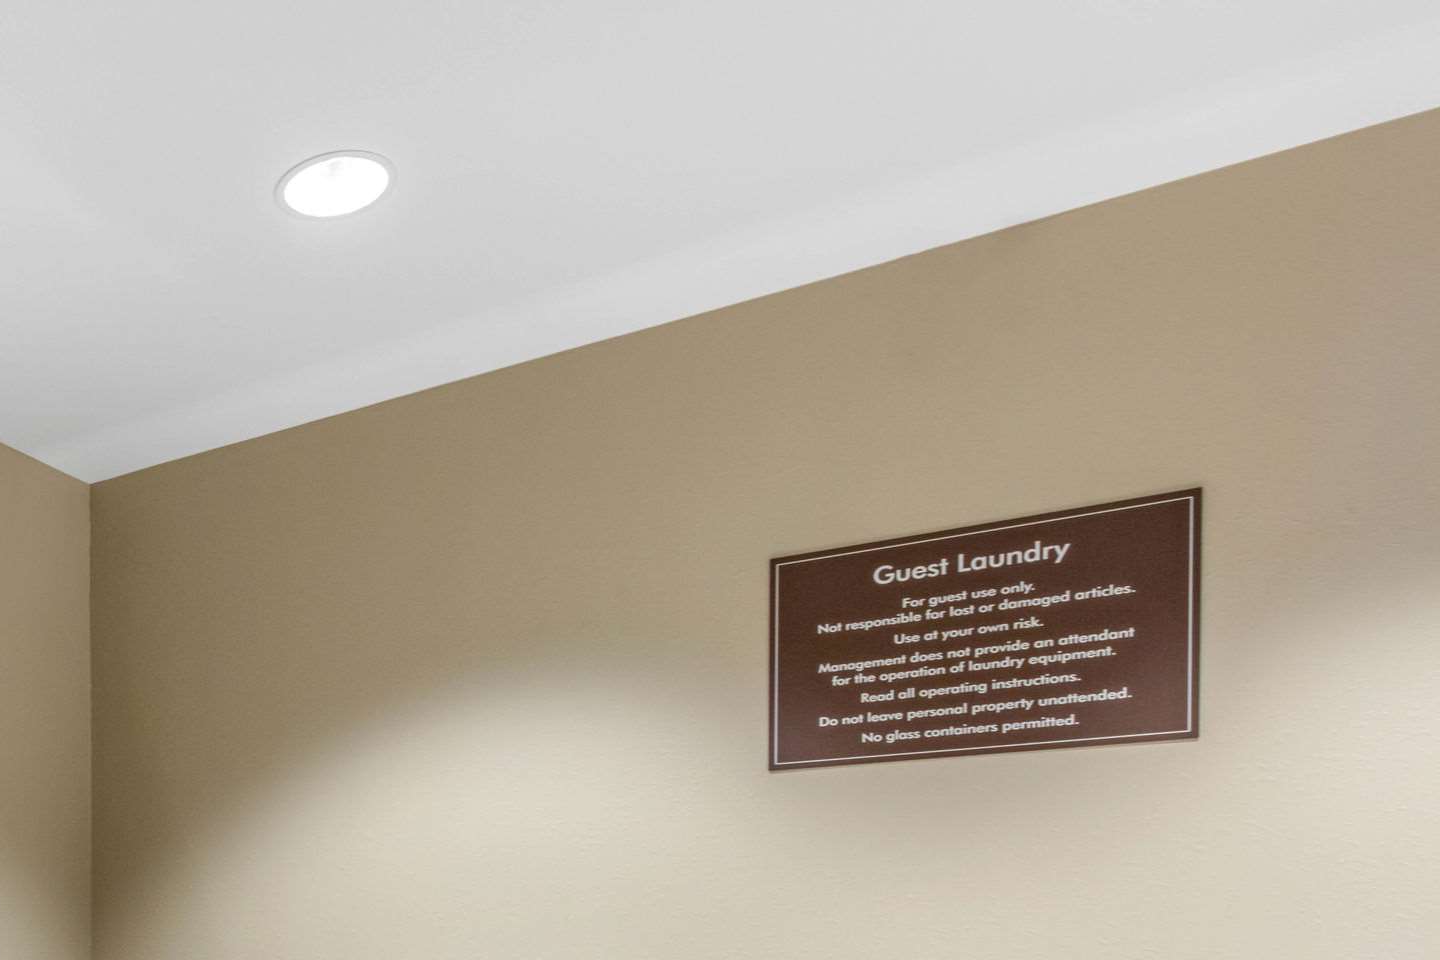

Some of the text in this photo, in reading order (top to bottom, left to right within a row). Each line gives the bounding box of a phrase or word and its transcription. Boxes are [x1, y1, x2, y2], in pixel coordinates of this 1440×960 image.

[872, 540, 1071, 584] Guest Laundry
[817, 583, 1136, 634] Not responsible for lost or damaged articles.
[902, 580, 1035, 608] For guest use only.
[817, 626, 1135, 673] Management does not provide an attendant
[893, 616, 1044, 644] Use at your own risk.
[831, 645, 1117, 686] for the operation of laundry equipment.
[818, 686, 1133, 727] Do not leave personal property unattended.
[860, 673, 1081, 703] Read all operating instructions.
[861, 713, 1080, 743] No glass containers permitted.
